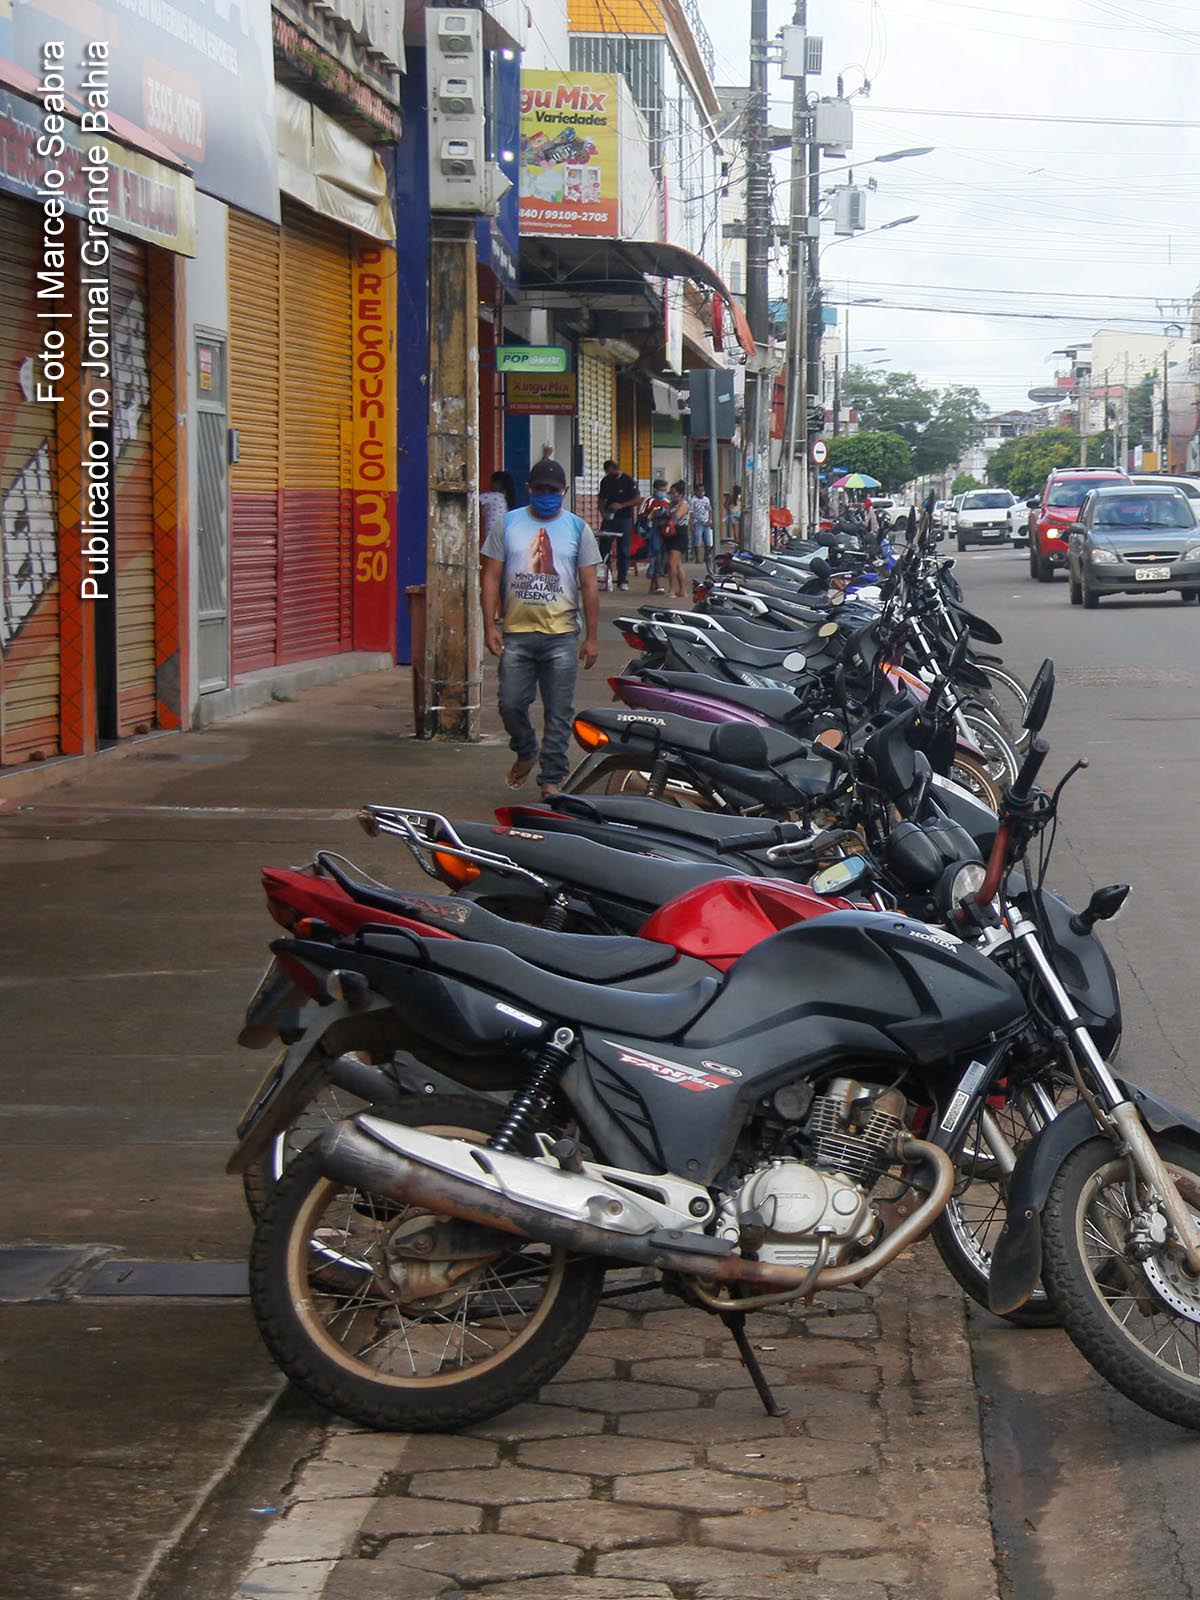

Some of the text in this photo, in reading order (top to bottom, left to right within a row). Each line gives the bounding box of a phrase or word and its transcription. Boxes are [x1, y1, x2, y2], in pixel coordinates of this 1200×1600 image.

[554, 84, 608, 113] Mix
[535, 111, 607, 126] Variedades
[544, 209, 609, 222] 99109-2705
[503, 354, 529, 364] POP
[616, 713, 667, 726] HONDA
[908, 930, 958, 954] HONDA
[619, 1052, 686, 1080] FAN
